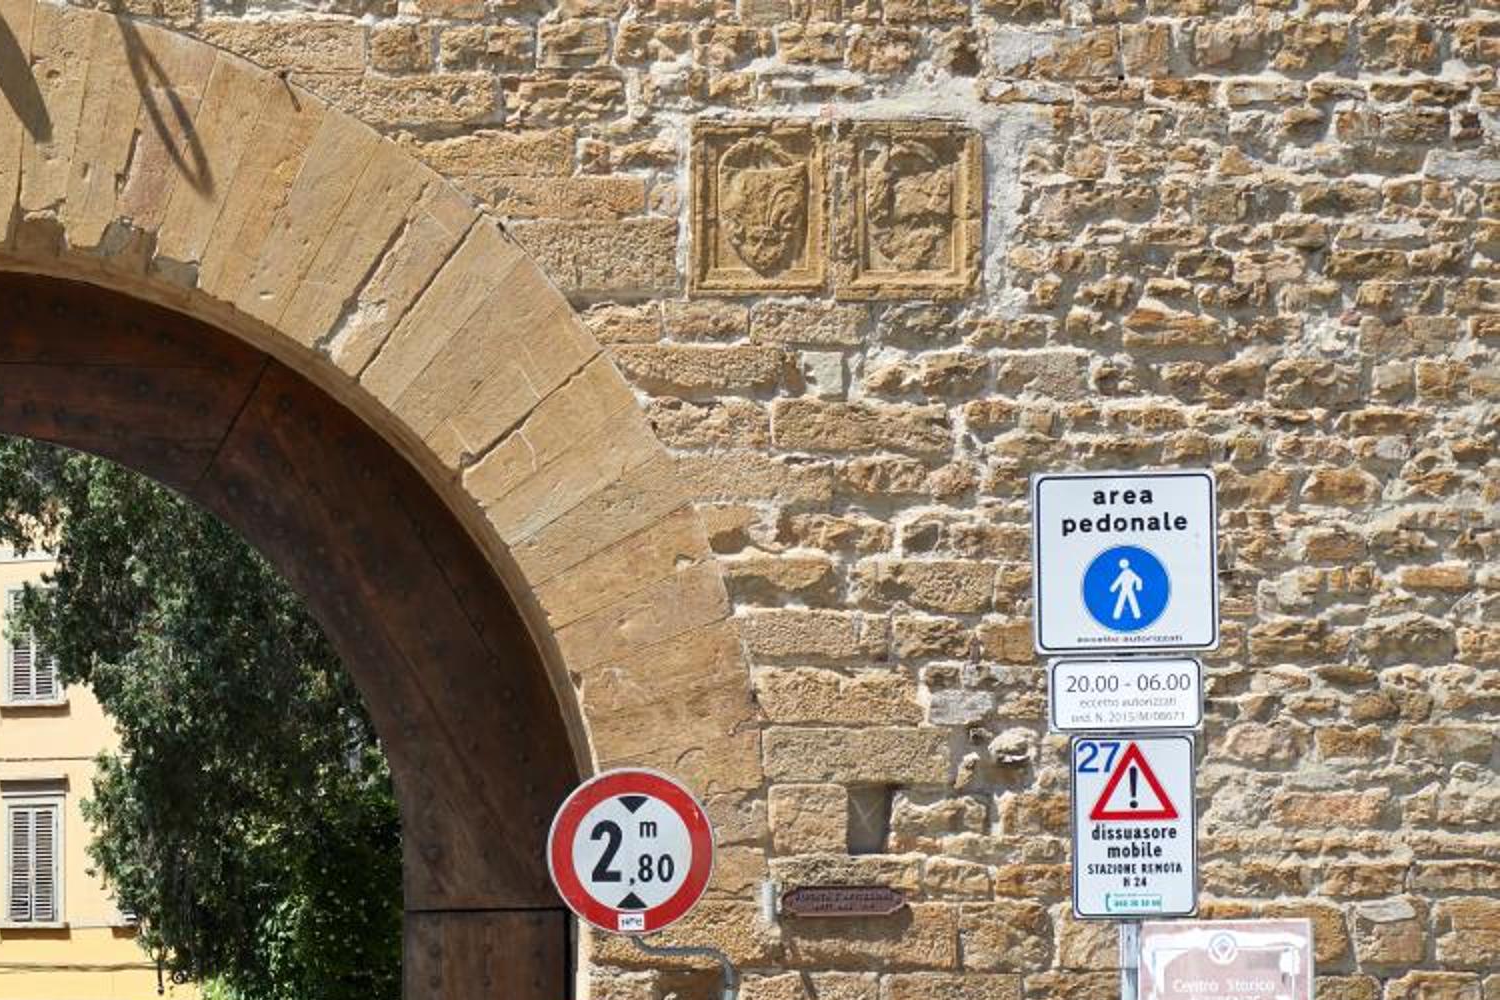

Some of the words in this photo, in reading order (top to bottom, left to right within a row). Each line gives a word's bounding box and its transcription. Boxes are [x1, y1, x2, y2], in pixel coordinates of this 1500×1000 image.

[1092, 488, 1154, 505] area
[1061, 513, 1189, 537] pedonale
[1066, 675, 1119, 693] 20.00
[1137, 673, 1191, 692] 06.00
[1077, 742, 1121, 774] 27
[1091, 824, 1177, 841] dissuasore
[1107, 842, 1163, 859] mobile
[1087, 863, 1137, 875] STAZIONE
[1142, 862, 1183, 874] REMOTA
[1134, 877, 1147, 887] 24
[1172, 979, 1219, 993] Centro
